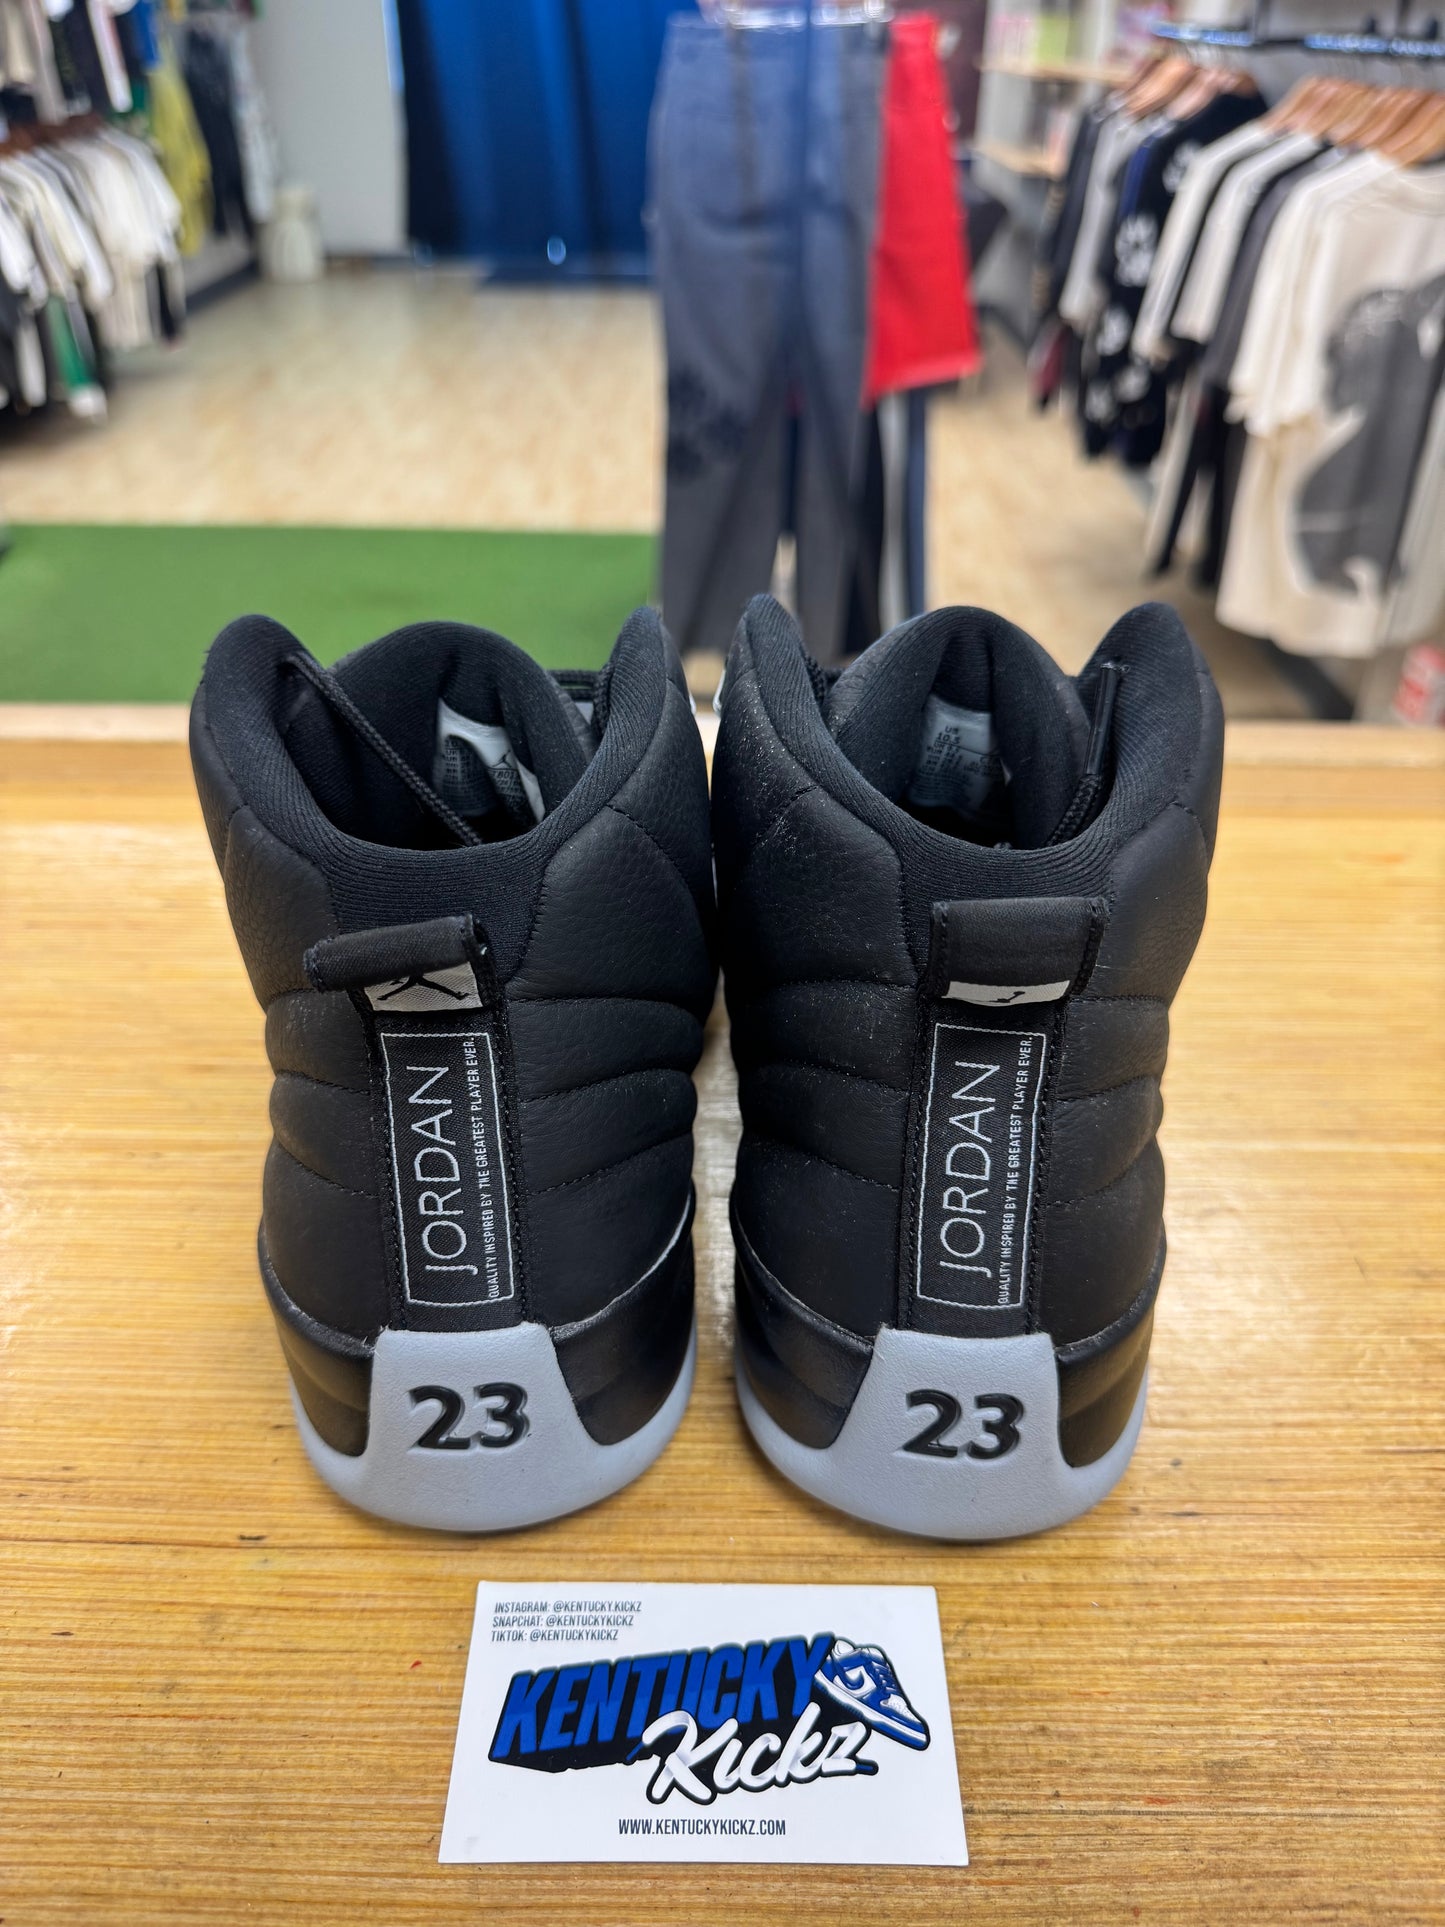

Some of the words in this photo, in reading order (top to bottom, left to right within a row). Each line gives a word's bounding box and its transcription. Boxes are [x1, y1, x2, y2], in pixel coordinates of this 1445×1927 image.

[463, 1037, 478, 1066] EVER.
[1018, 1037, 1033, 1066] EVER.
[467, 1069, 482, 1111] PLAYER
[1012, 1070, 1029, 1110] PLAYER
[471, 1116, 488, 1168] GREATEST
[1008, 1113, 1022, 1168] GREATEST
[406, 1066, 478, 1275] JORDAN
[478, 1170, 491, 1189] THE
[940, 1061, 1000, 1278] JORDAN
[1006, 1171, 1019, 1191] THE
[480, 1193, 493, 1207] BY
[1004, 1196, 1017, 1210] BY
[482, 1209, 496, 1254] INSPIRED
[1000, 1213, 1015, 1258] INSPIRED
[485, 1256, 500, 1298] QUALITY
[997, 1261, 1012, 1304] QUALITY
[409, 1382, 531, 1450] 23
[902, 1389, 1024, 1460] 23
[492, 1615, 543, 1628] SNAPCHAT:
[546, 1614, 634, 1627] @KENTUCKYKICKZ
[494, 1601, 551, 1613] INSTAGRAM:
[491, 1629, 527, 1642] TIKTOK:
[530, 1629, 619, 1642] @KENTUCKYKICKZ
[492, 1634, 836, 1760] KENTUCKY
[642, 1702, 866, 1802] Kickz
[618, 1818, 786, 1836] WWW.KENTUCKYKICKZ.COM
